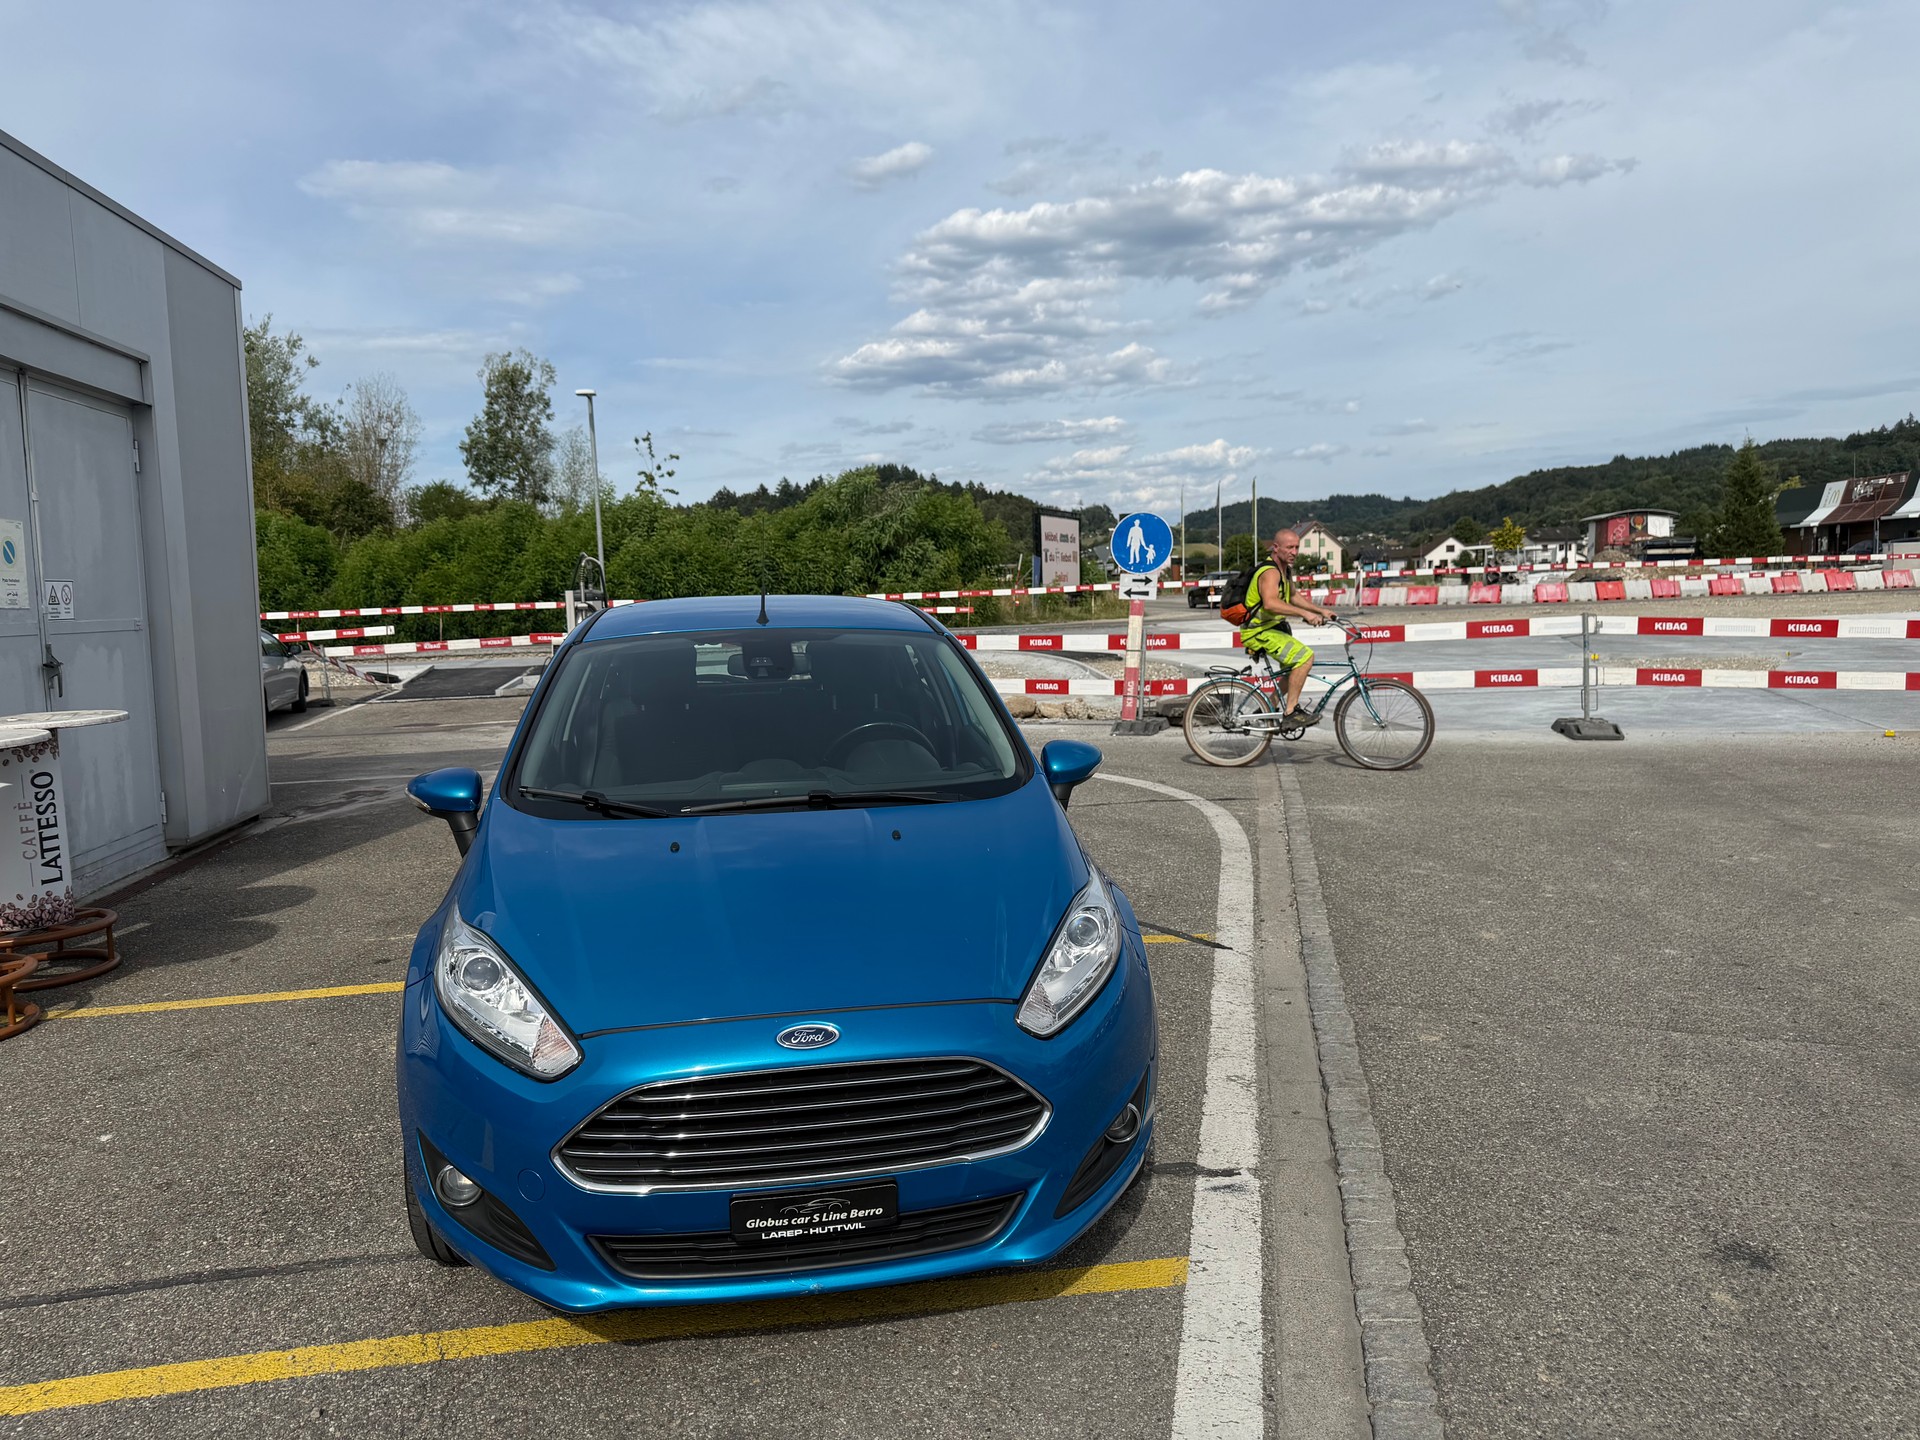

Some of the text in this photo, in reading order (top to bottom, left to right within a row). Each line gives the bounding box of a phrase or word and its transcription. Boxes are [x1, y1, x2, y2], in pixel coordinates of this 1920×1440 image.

[1482, 624, 1514, 633] KIBAG
[1654, 621, 1688, 631] KIBAG
[1788, 623, 1822, 633] KIBAG
[1361, 630, 1391, 638] KIBAG
[1490, 674, 1523, 683] KIBAG
[1652, 673, 1686, 682] KIBAG
[1784, 675, 1819, 685] KIBAG
[13, 801, 38, 860] CAFFÈ
[30, 771, 64, 886] LATTESSO
[791, 1029, 825, 1043] Ford
[746, 1207, 884, 1229] Globus car S Line Berro
